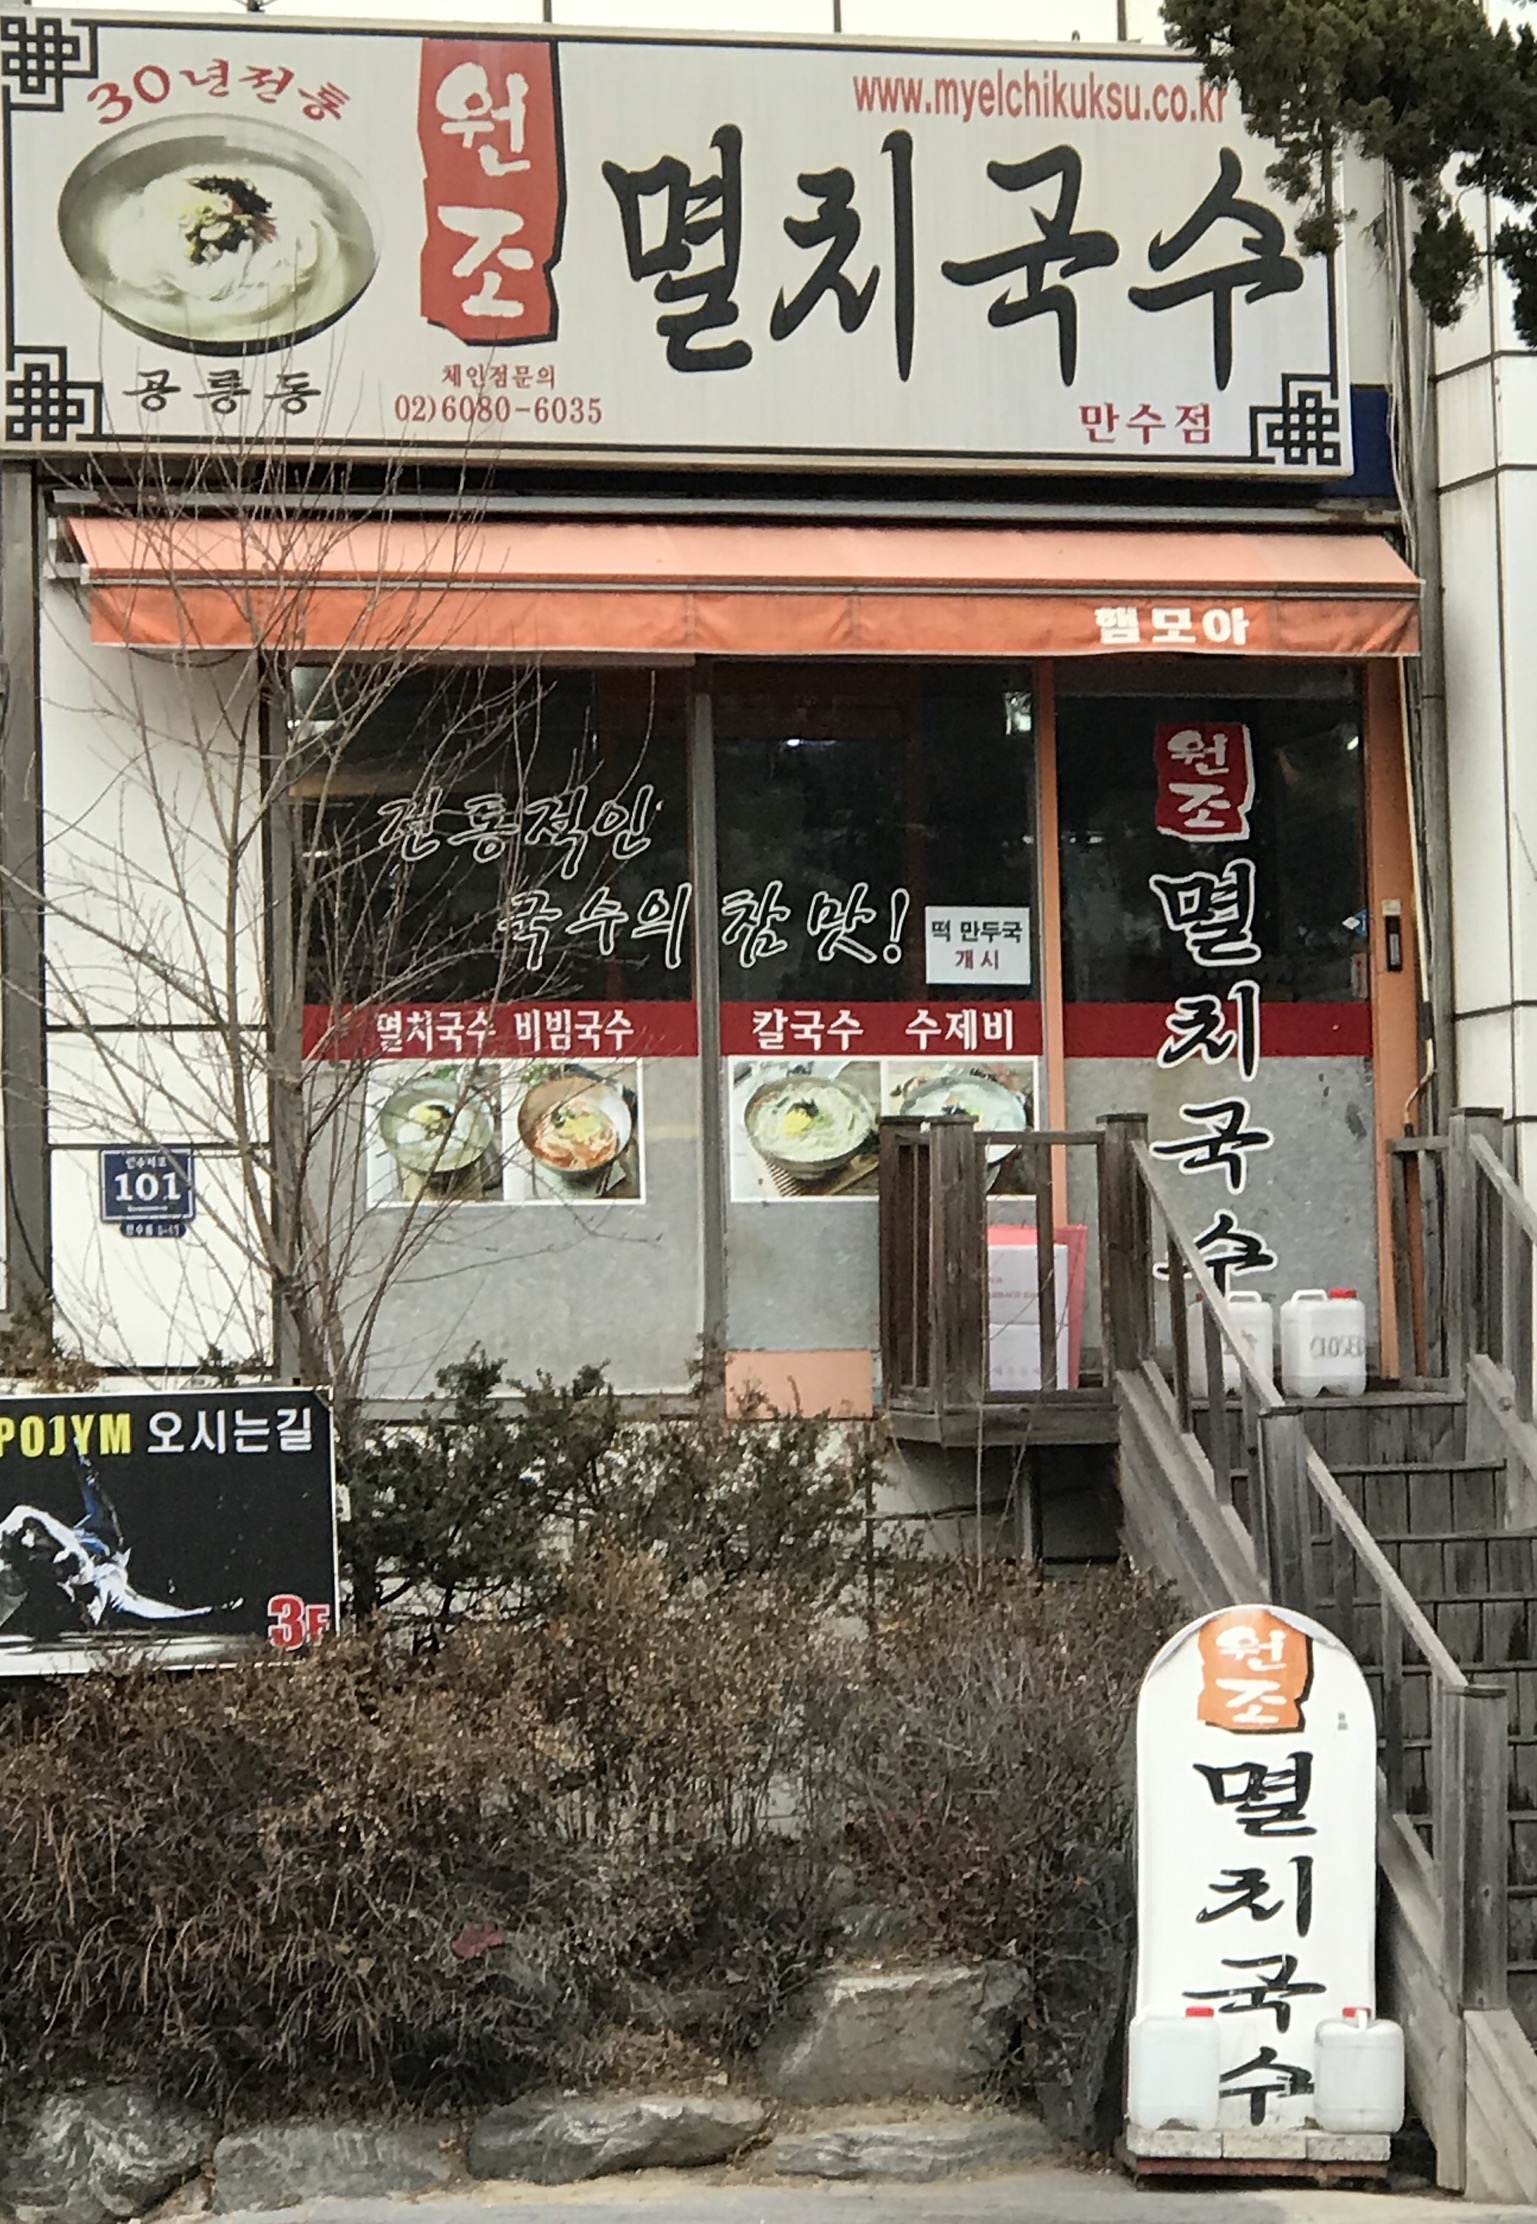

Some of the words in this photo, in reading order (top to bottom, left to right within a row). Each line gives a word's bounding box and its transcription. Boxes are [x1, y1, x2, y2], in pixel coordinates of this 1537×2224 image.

[87, 58, 351, 124] 30년전통
[853, 69, 1228, 123] www.myelchikuksu.co.kr
[436, 61, 533, 318] 원조
[602, 124, 1304, 391] 멸치국수
[123, 369, 321, 414] 공릉동
[395, 394, 602, 425] 02)6080-6035
[1079, 403, 1212, 444] 만수점
[1167, 730, 1232, 830] 원조
[377, 784, 655, 880] 전통적인
[497, 882, 692, 971] 국수의
[931, 919, 951, 943] 떡
[960, 919, 1023, 943] 만두국
[377, 1008, 497, 1053] 멸치국수
[513, 1008, 635, 1052] 비빔국수
[752, 1008, 864, 1052] 칼국수
[905, 1008, 1014, 1052] 수제비
[1150, 857, 1278, 1299] 멸치국수
[114, 1172, 182, 1202] 101
[147, 1409, 313, 1455] 오시는길
[267, 1593, 331, 1653] 3F
[1215, 1625, 1287, 1725] 원조
[1181, 1750, 1327, 2127] 멸치국수
